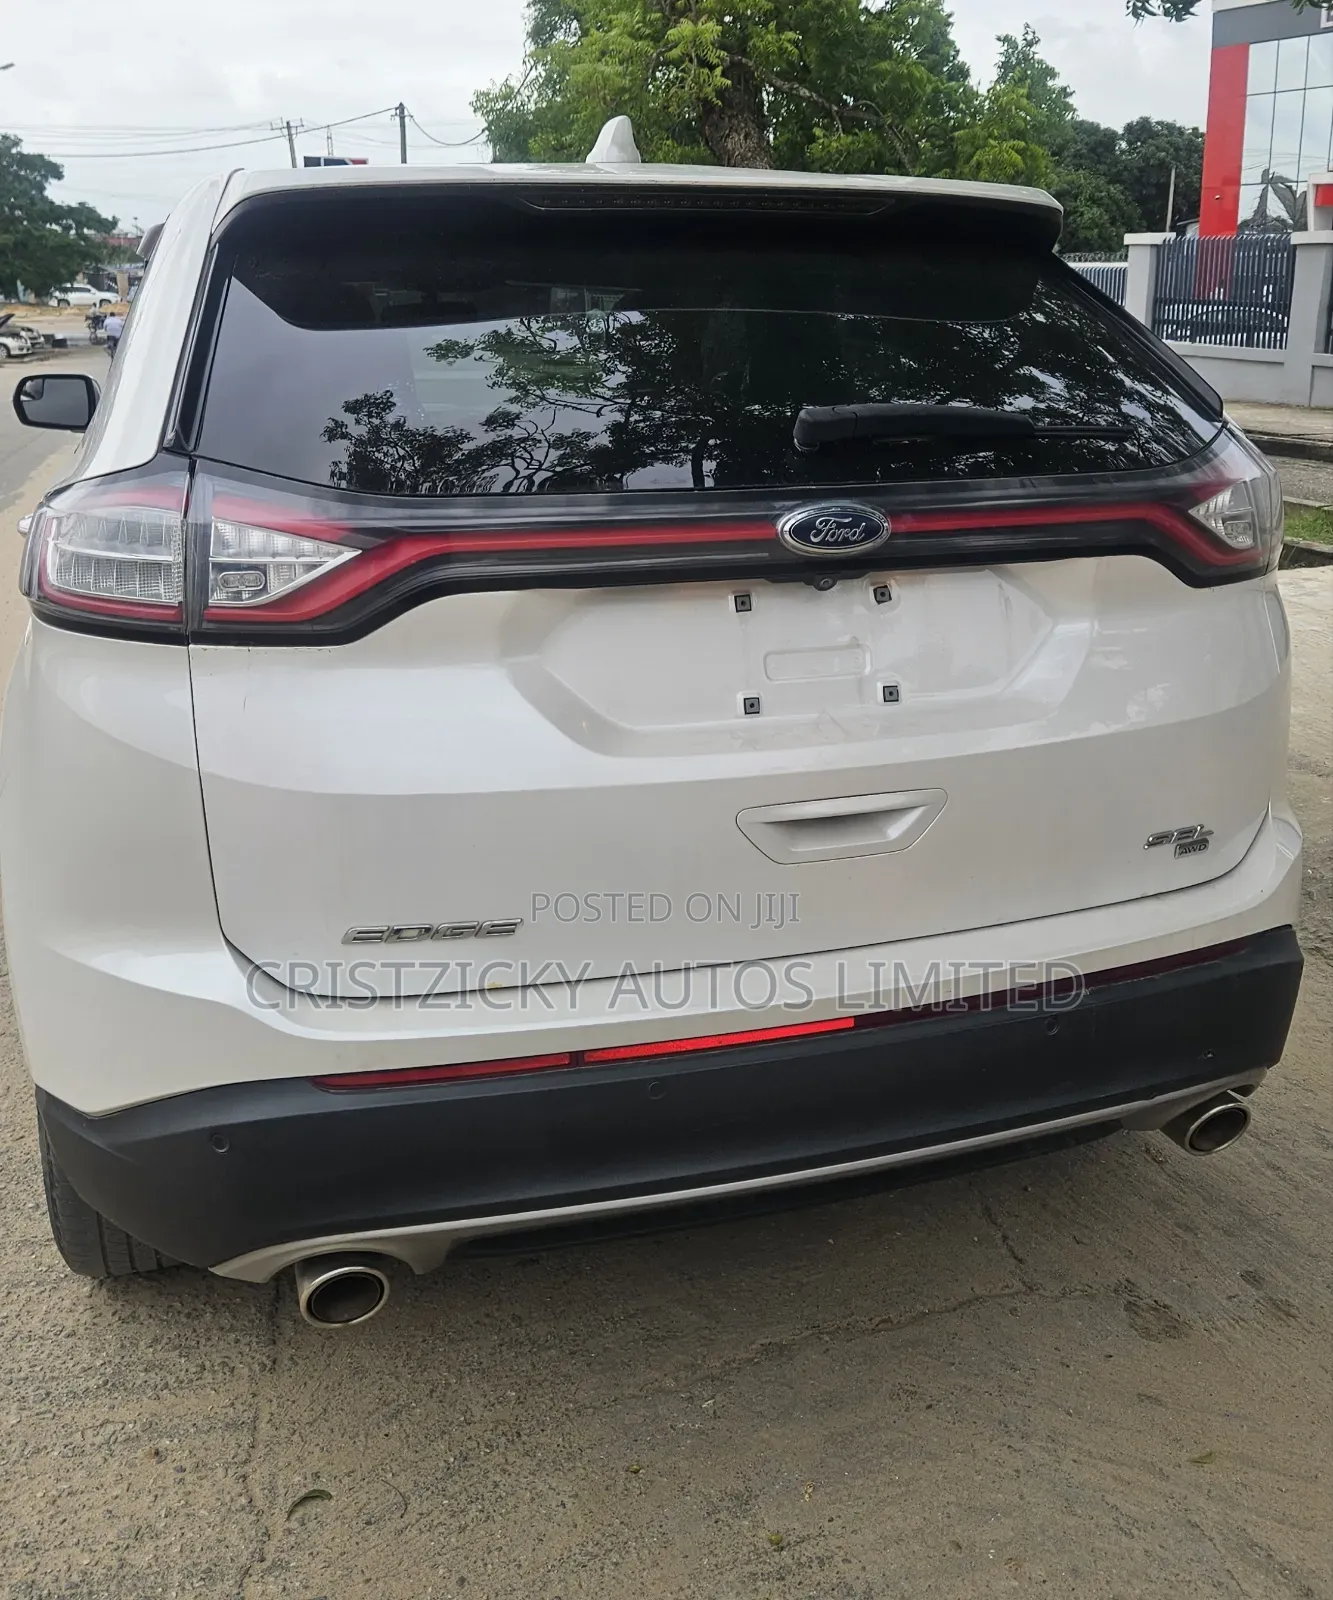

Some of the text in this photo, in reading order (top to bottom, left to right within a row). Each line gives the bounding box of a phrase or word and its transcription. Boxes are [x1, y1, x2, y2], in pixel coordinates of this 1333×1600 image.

[809, 516, 867, 543] Ford
[1143, 823, 1215, 850] SEL
[1179, 843, 1207, 856] AWD
[341, 917, 523, 945] EDGE
